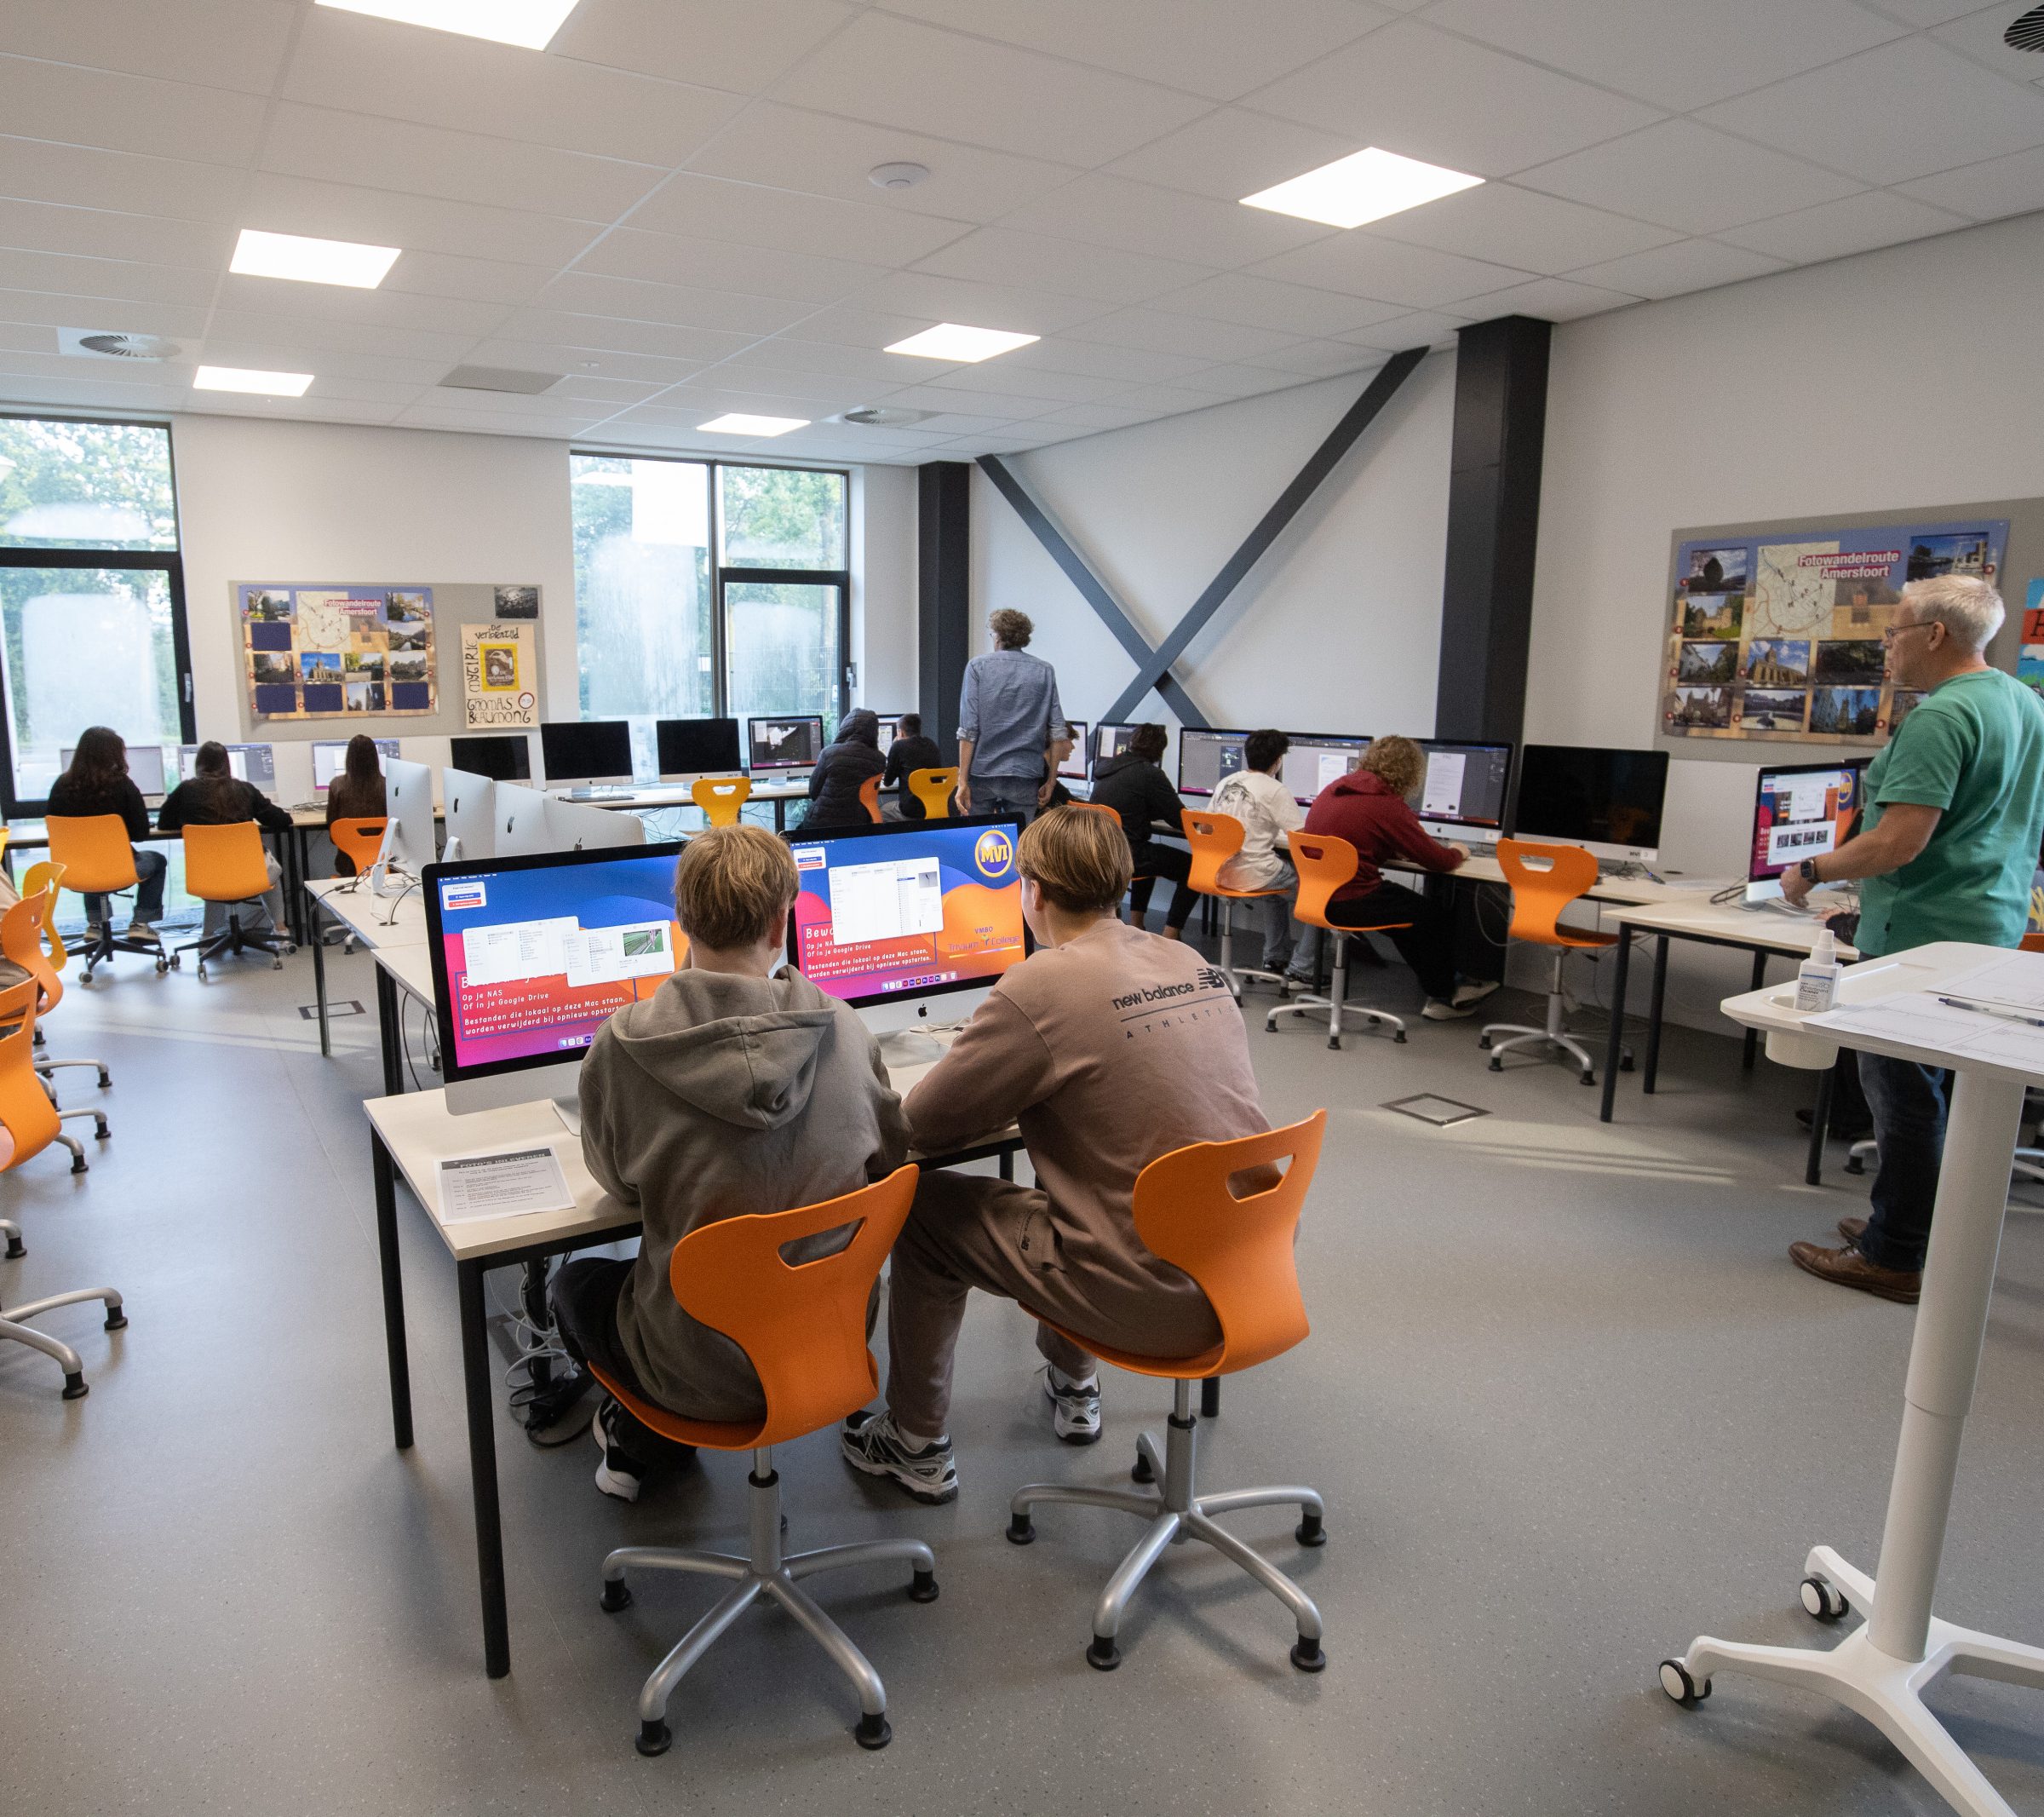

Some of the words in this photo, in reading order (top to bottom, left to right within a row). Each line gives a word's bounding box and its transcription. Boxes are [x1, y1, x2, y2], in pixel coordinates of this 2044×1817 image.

[1799, 551, 1899, 566] Fotowandelroute
[1821, 565, 1890, 578] Amersfoort
[324, 599, 382, 607] Fotowandelroute
[338, 607, 377, 616] Amersfoort
[980, 844, 1008, 863] MVI
[974, 926, 994, 934] VMBO
[991, 936, 1020, 946] College
[833, 946, 853, 954] Google
[807, 961, 840, 970] Bestanden
[808, 970, 830, 979] worden
[832, 964, 864, 975] verwijderd
[876, 959, 900, 969] opnieuw
[475, 992, 484, 1001] je
[487, 989, 502, 998] NAS
[486, 1000, 495, 1009] je
[498, 996, 525, 1005] Google
[528, 992, 549, 1001] Drive
[1111, 992, 1142, 1010] new
[1141, 981, 1195, 1003] balance
[464, 1014, 507, 1026] Bestanden
[525, 1007, 549, 1016] lokaal
[564, 1002, 582, 1010] deze
[465, 1025, 494, 1035] worden
[497, 1017, 541, 1030] verwijderd
[543, 1015, 554, 1024] bij
[557, 1011, 589, 1021] opnieuw
[590, 1005, 620, 1016] opstart
